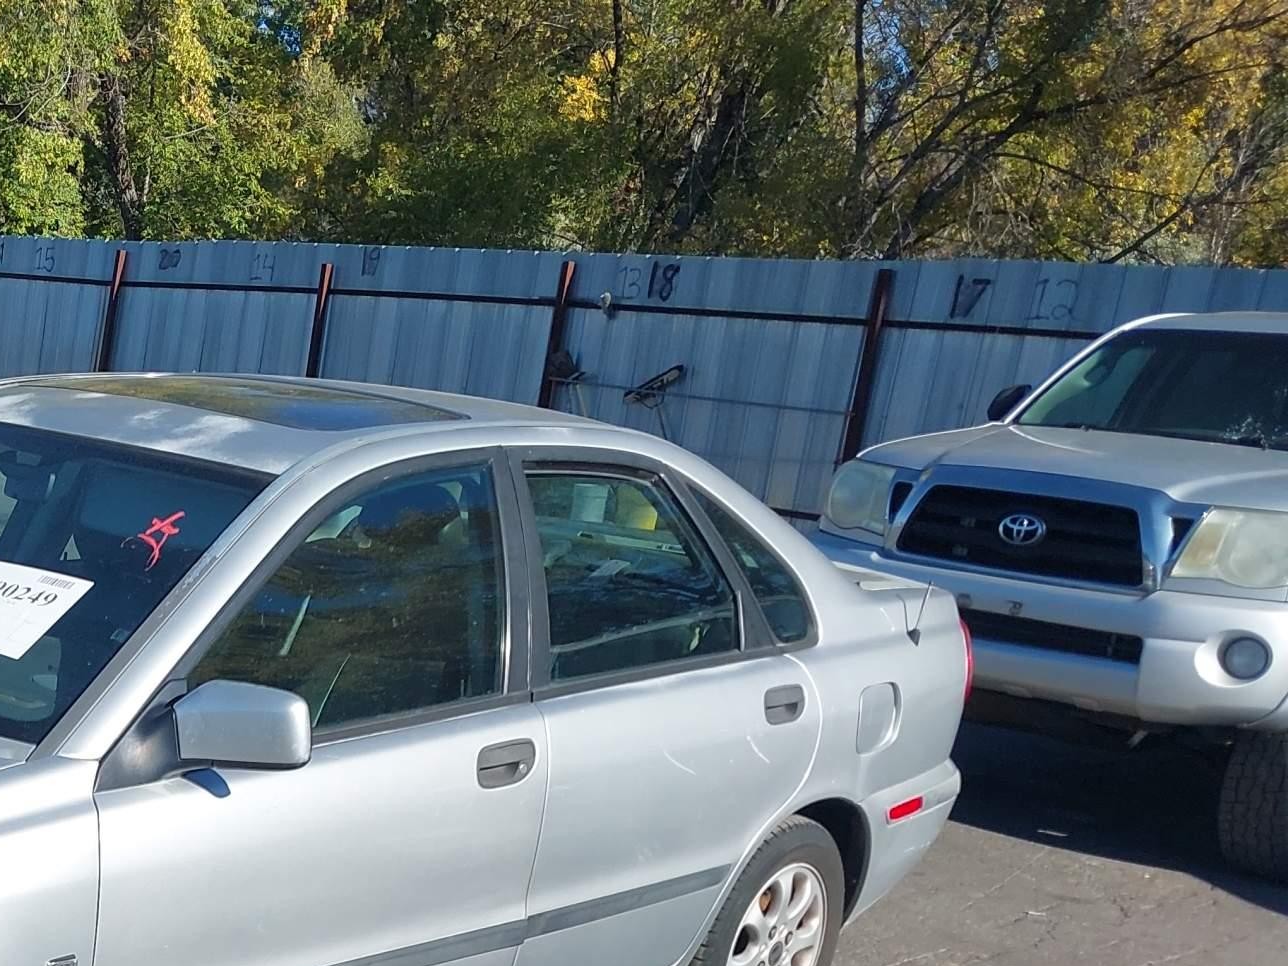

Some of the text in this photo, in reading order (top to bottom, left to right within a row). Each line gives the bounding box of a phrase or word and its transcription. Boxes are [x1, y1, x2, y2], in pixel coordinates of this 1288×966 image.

[33, 247, 56, 273] 15
[249, 253, 277, 282] 14
[362, 246, 381, 277] 19
[616, 265, 642, 300] 13
[647, 260, 681, 302] 18
[949, 274, 992, 319] 17
[1024, 278, 1079, 321] 12
